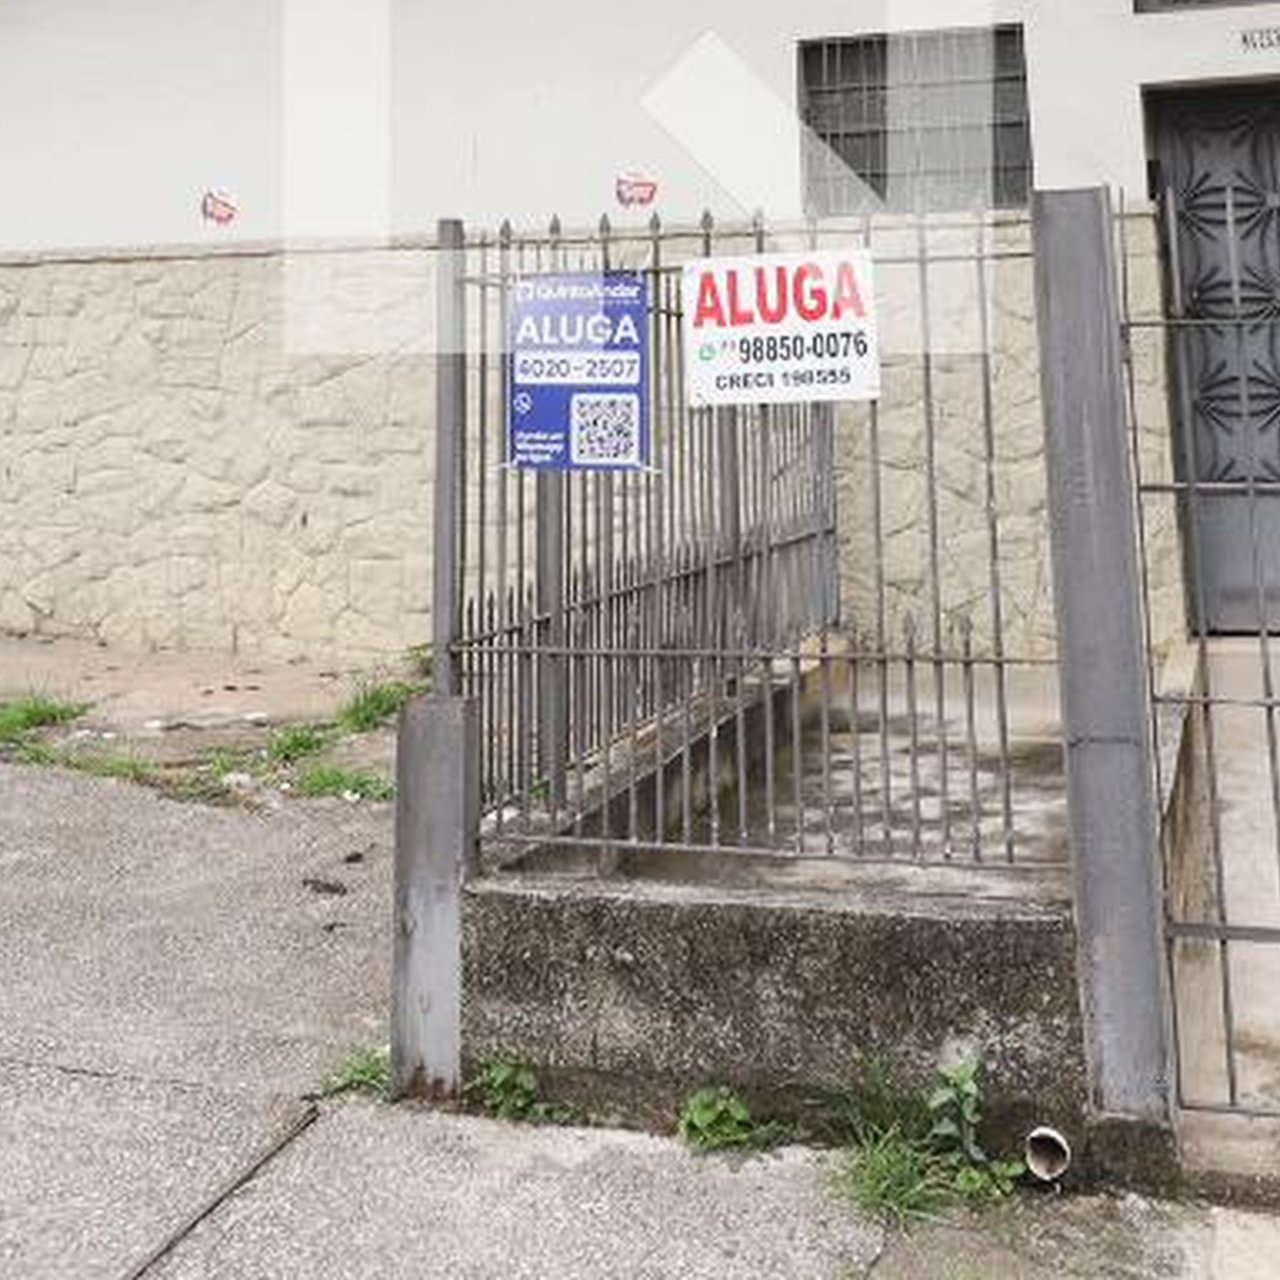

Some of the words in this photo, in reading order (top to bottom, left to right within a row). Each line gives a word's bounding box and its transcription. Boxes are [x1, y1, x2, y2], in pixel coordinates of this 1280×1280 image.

[693, 260, 866, 327] ALUGA
[516, 314, 640, 344] ALUGA
[739, 330, 868, 364] 98850-0076
[519, 358, 638, 378] 4020-2507
[715, 372, 774, 390] CRECI
